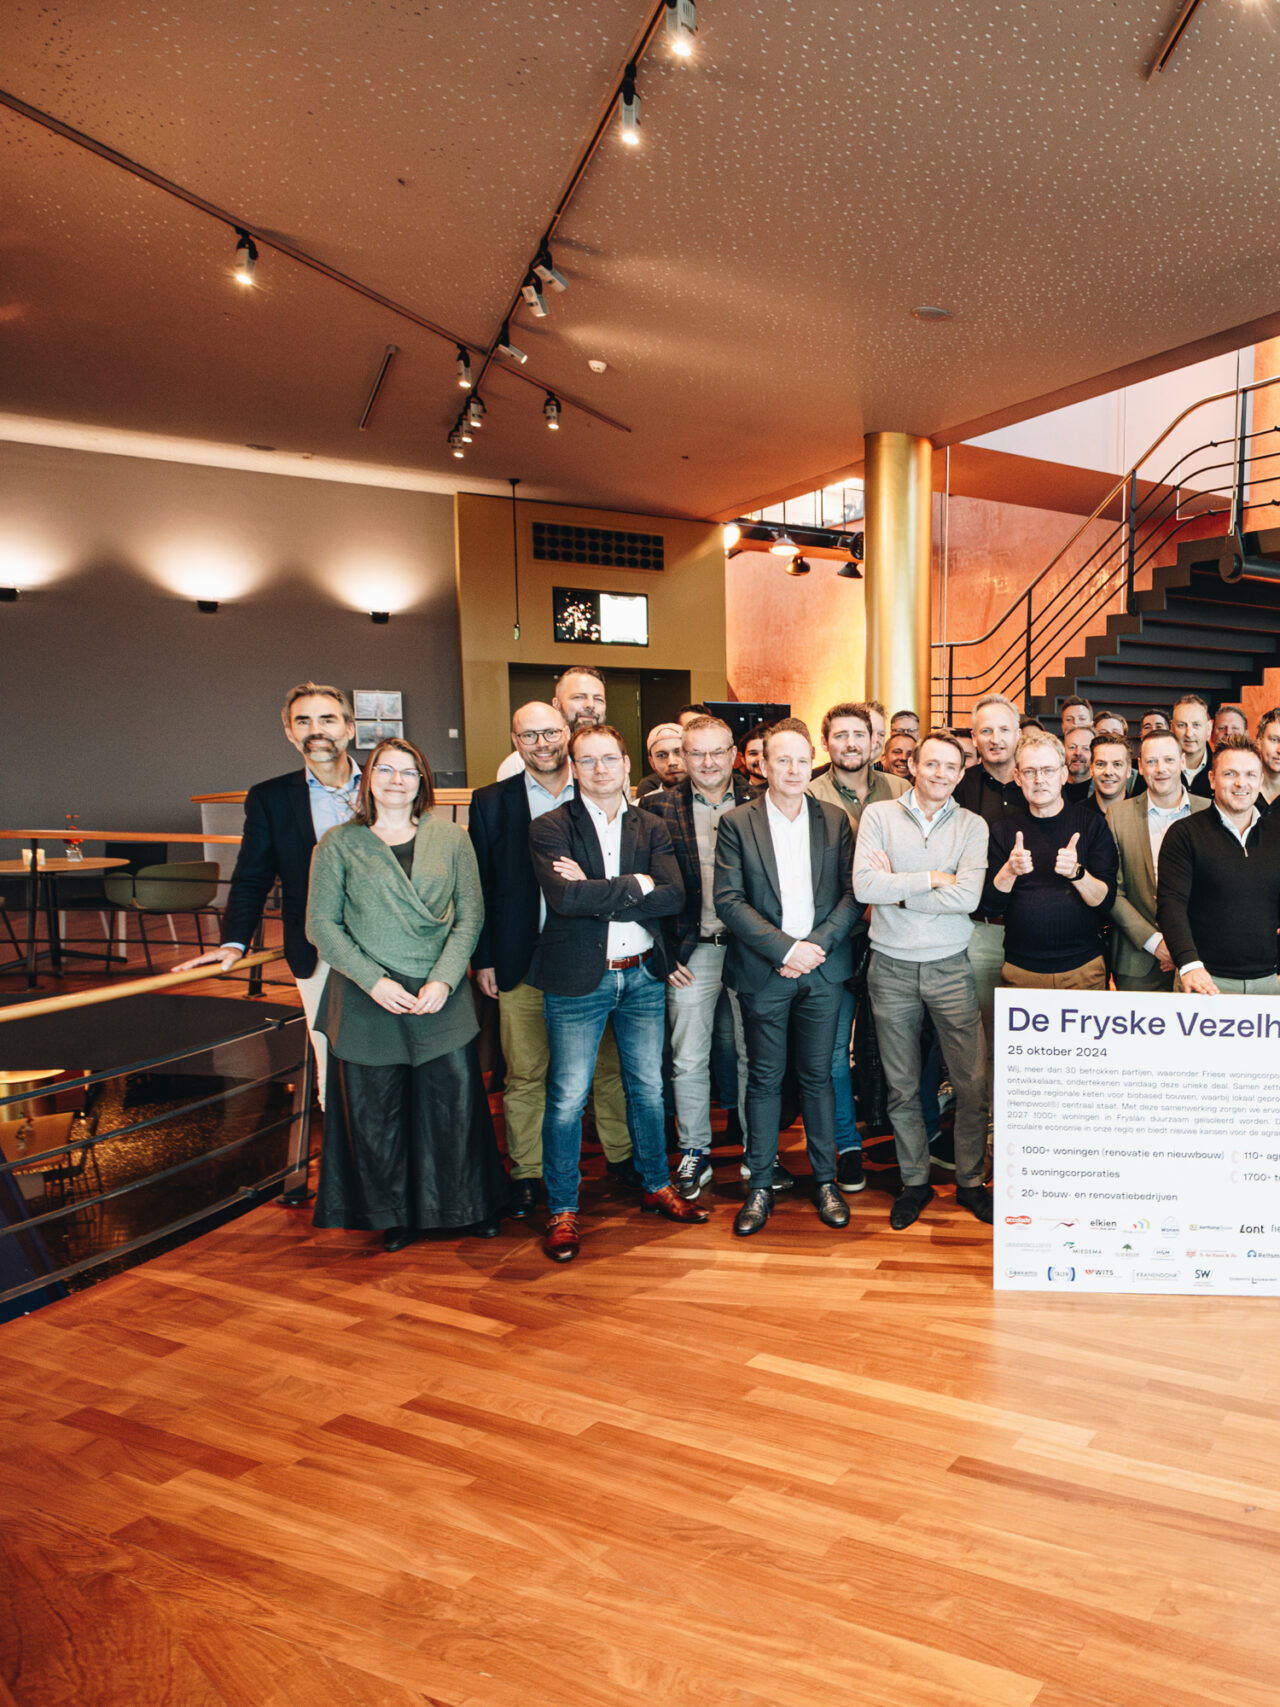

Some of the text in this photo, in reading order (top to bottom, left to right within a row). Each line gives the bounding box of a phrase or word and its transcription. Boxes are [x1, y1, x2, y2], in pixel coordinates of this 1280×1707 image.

[1008, 1007, 1050, 1032] De
[1060, 1008, 1166, 1041] Fryske
[1008, 1045, 1107, 1057] 25 oktober 2024
[1047, 1066, 1063, 1074] dan
[1065, 1066, 1077, 1074] 30
[1202, 1070, 1226, 1078] Friese
[1066, 1079, 1121, 1087] ondertekenen
[1123, 1081, 1158, 1089] vandaag
[1232, 1082, 1261, 1090] Samen
[1007, 1088, 1042, 1098] volledige
[1043, 1090, 1081, 1098] regionale
[1127, 1092, 1163, 1100] biobased
[1200, 1094, 1230, 1102] waarbij
[1160, 1105, 1218, 1113] samenwerking
[1219, 1106, 1247, 1114] zorgen
[1007, 1110, 1029, 1119] 2027
[1062, 1114, 1100, 1122] woningen
[1007, 1123, 1044, 1131] circulaire
[1044, 1124, 1083, 1132] economie
[1113, 1127, 1135, 1135] regio
[1022, 1145, 1050, 1155] 1000+
[1053, 1148, 1100, 1158] woningen
[1102, 1149, 1151, 1157] (renovatie
[1167, 1151, 1225, 1159] nieuwbouw)
[1244, 1151, 1263, 1160] 110+
[1021, 1167, 1120, 1179] 5 woningcorporaties
[1244, 1172, 1271, 1182] 1700+
[1021, 1189, 1039, 1198] 20+
[1041, 1190, 1071, 1198] bouw-
[1088, 1192, 1178, 1201] renovatiebedrijven
[1090, 1219, 1117, 1227] elkien
[1240, 1224, 1265, 1234] Lont
[1194, 1269, 1211, 1279] SW
